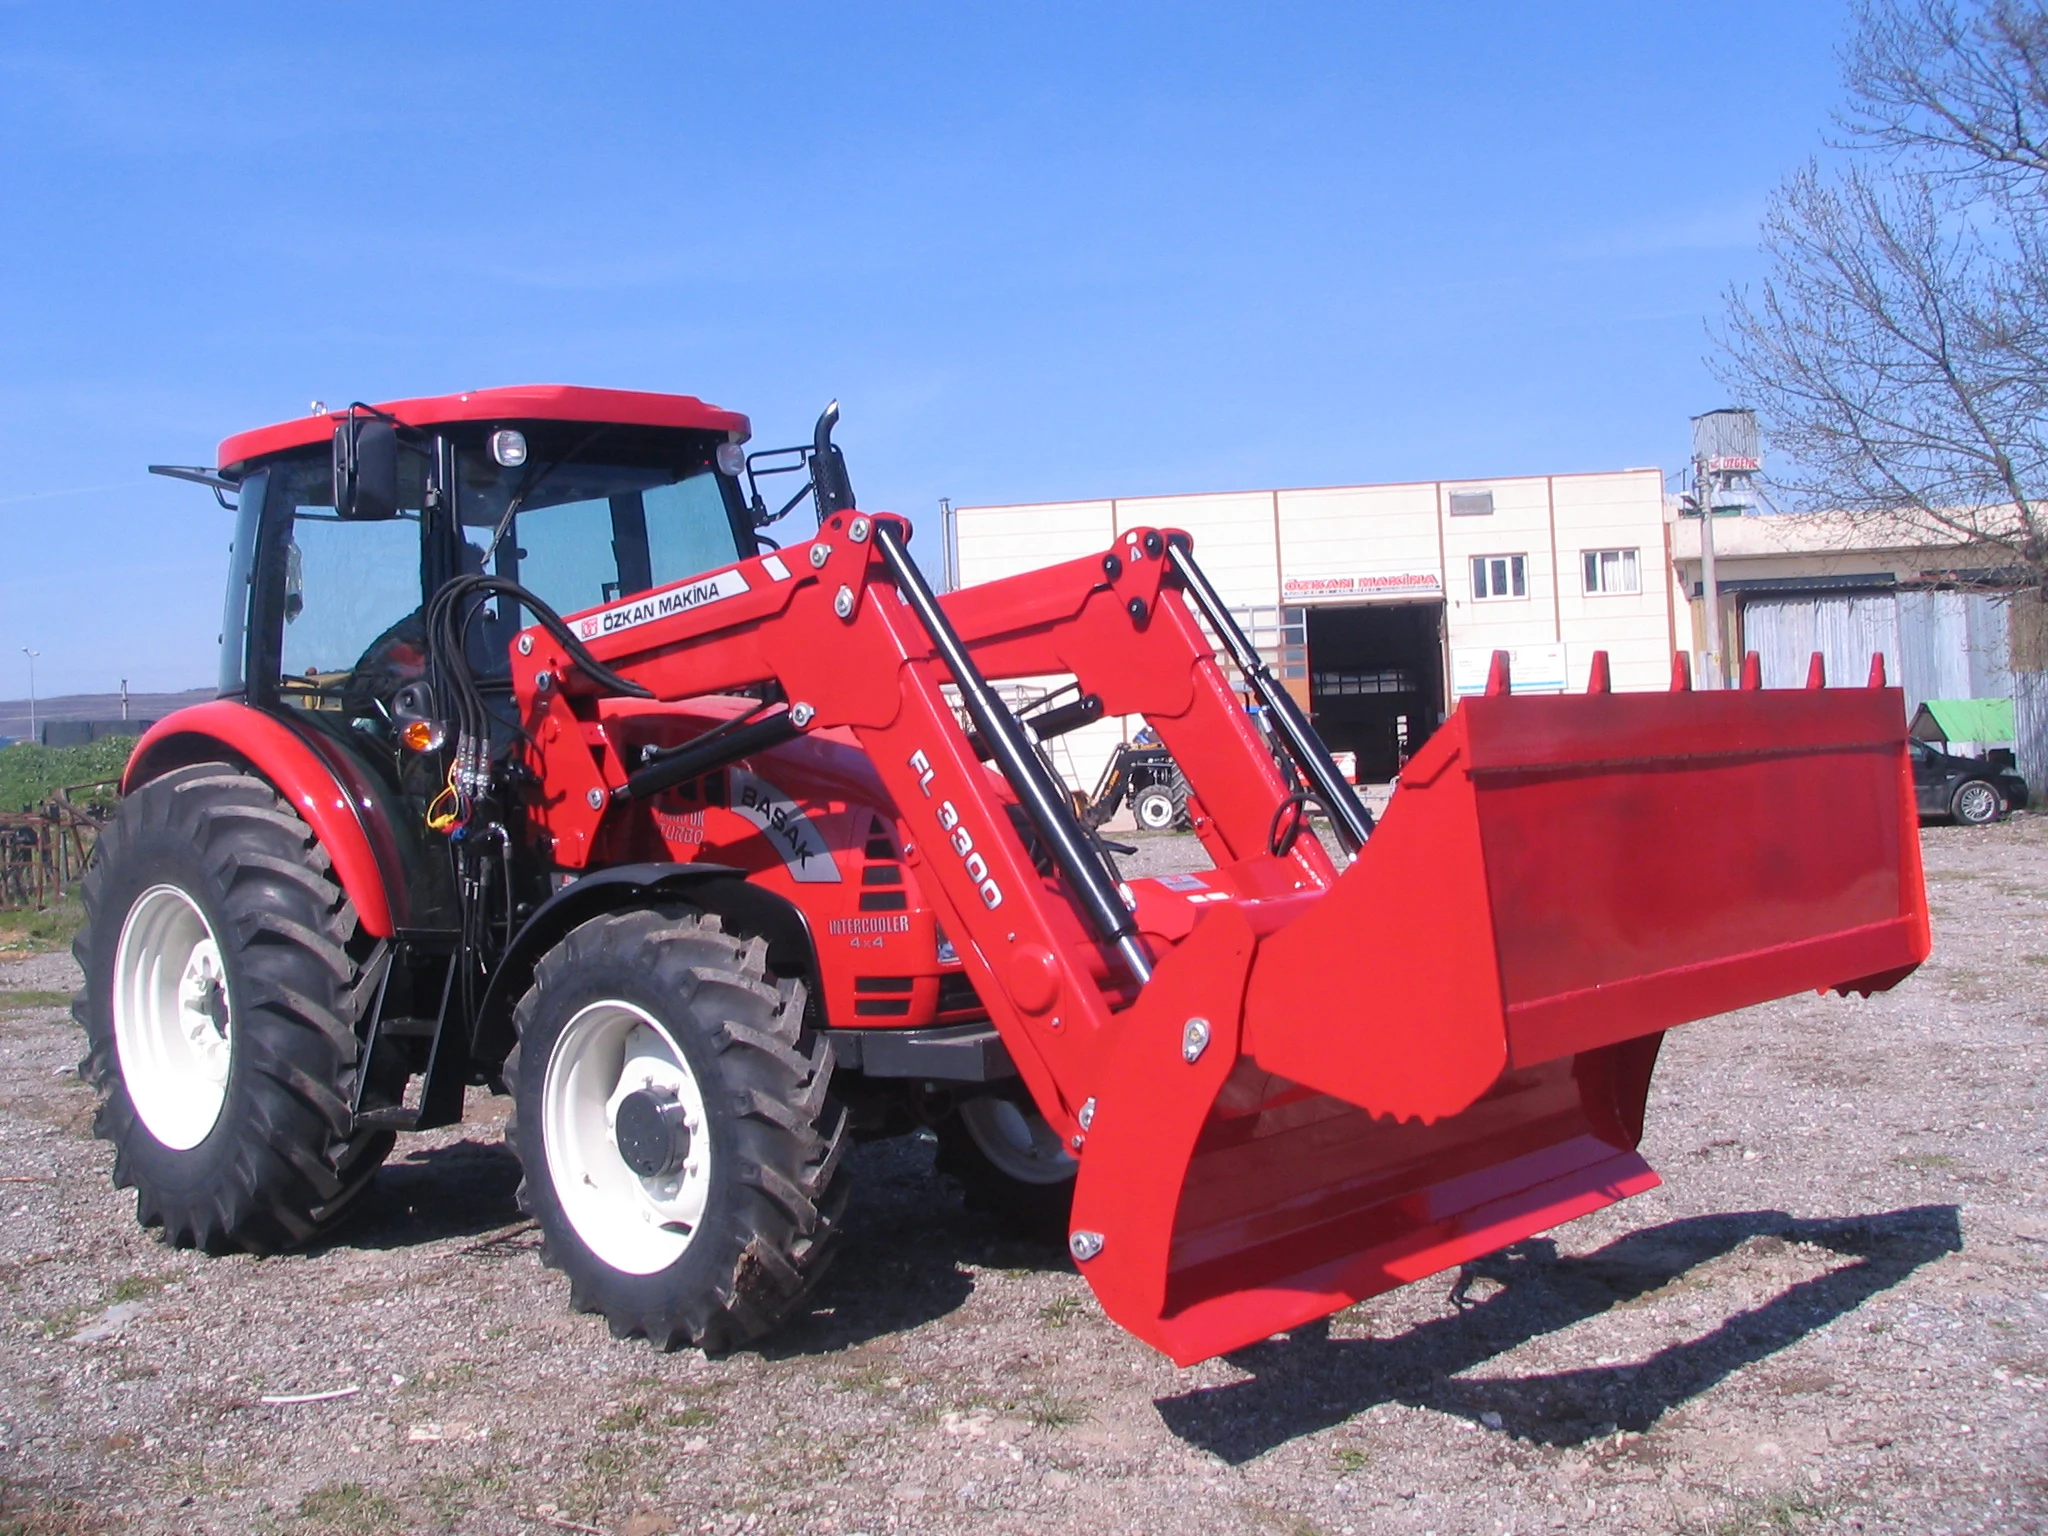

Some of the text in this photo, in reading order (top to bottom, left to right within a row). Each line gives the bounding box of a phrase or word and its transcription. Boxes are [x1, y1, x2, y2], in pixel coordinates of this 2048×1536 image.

[1284, 578, 1354, 591] ÖZKAN
[1358, 573, 1438, 588] MAKİNA
[603, 582, 719, 631] ÖZKAN MAKİNA
[660, 823, 704, 845] TURBO
[741, 786, 814, 870] BAŞAK
[908, 749, 1003, 910] FL 3300
[828, 915, 910, 935] INTERCOOLER
